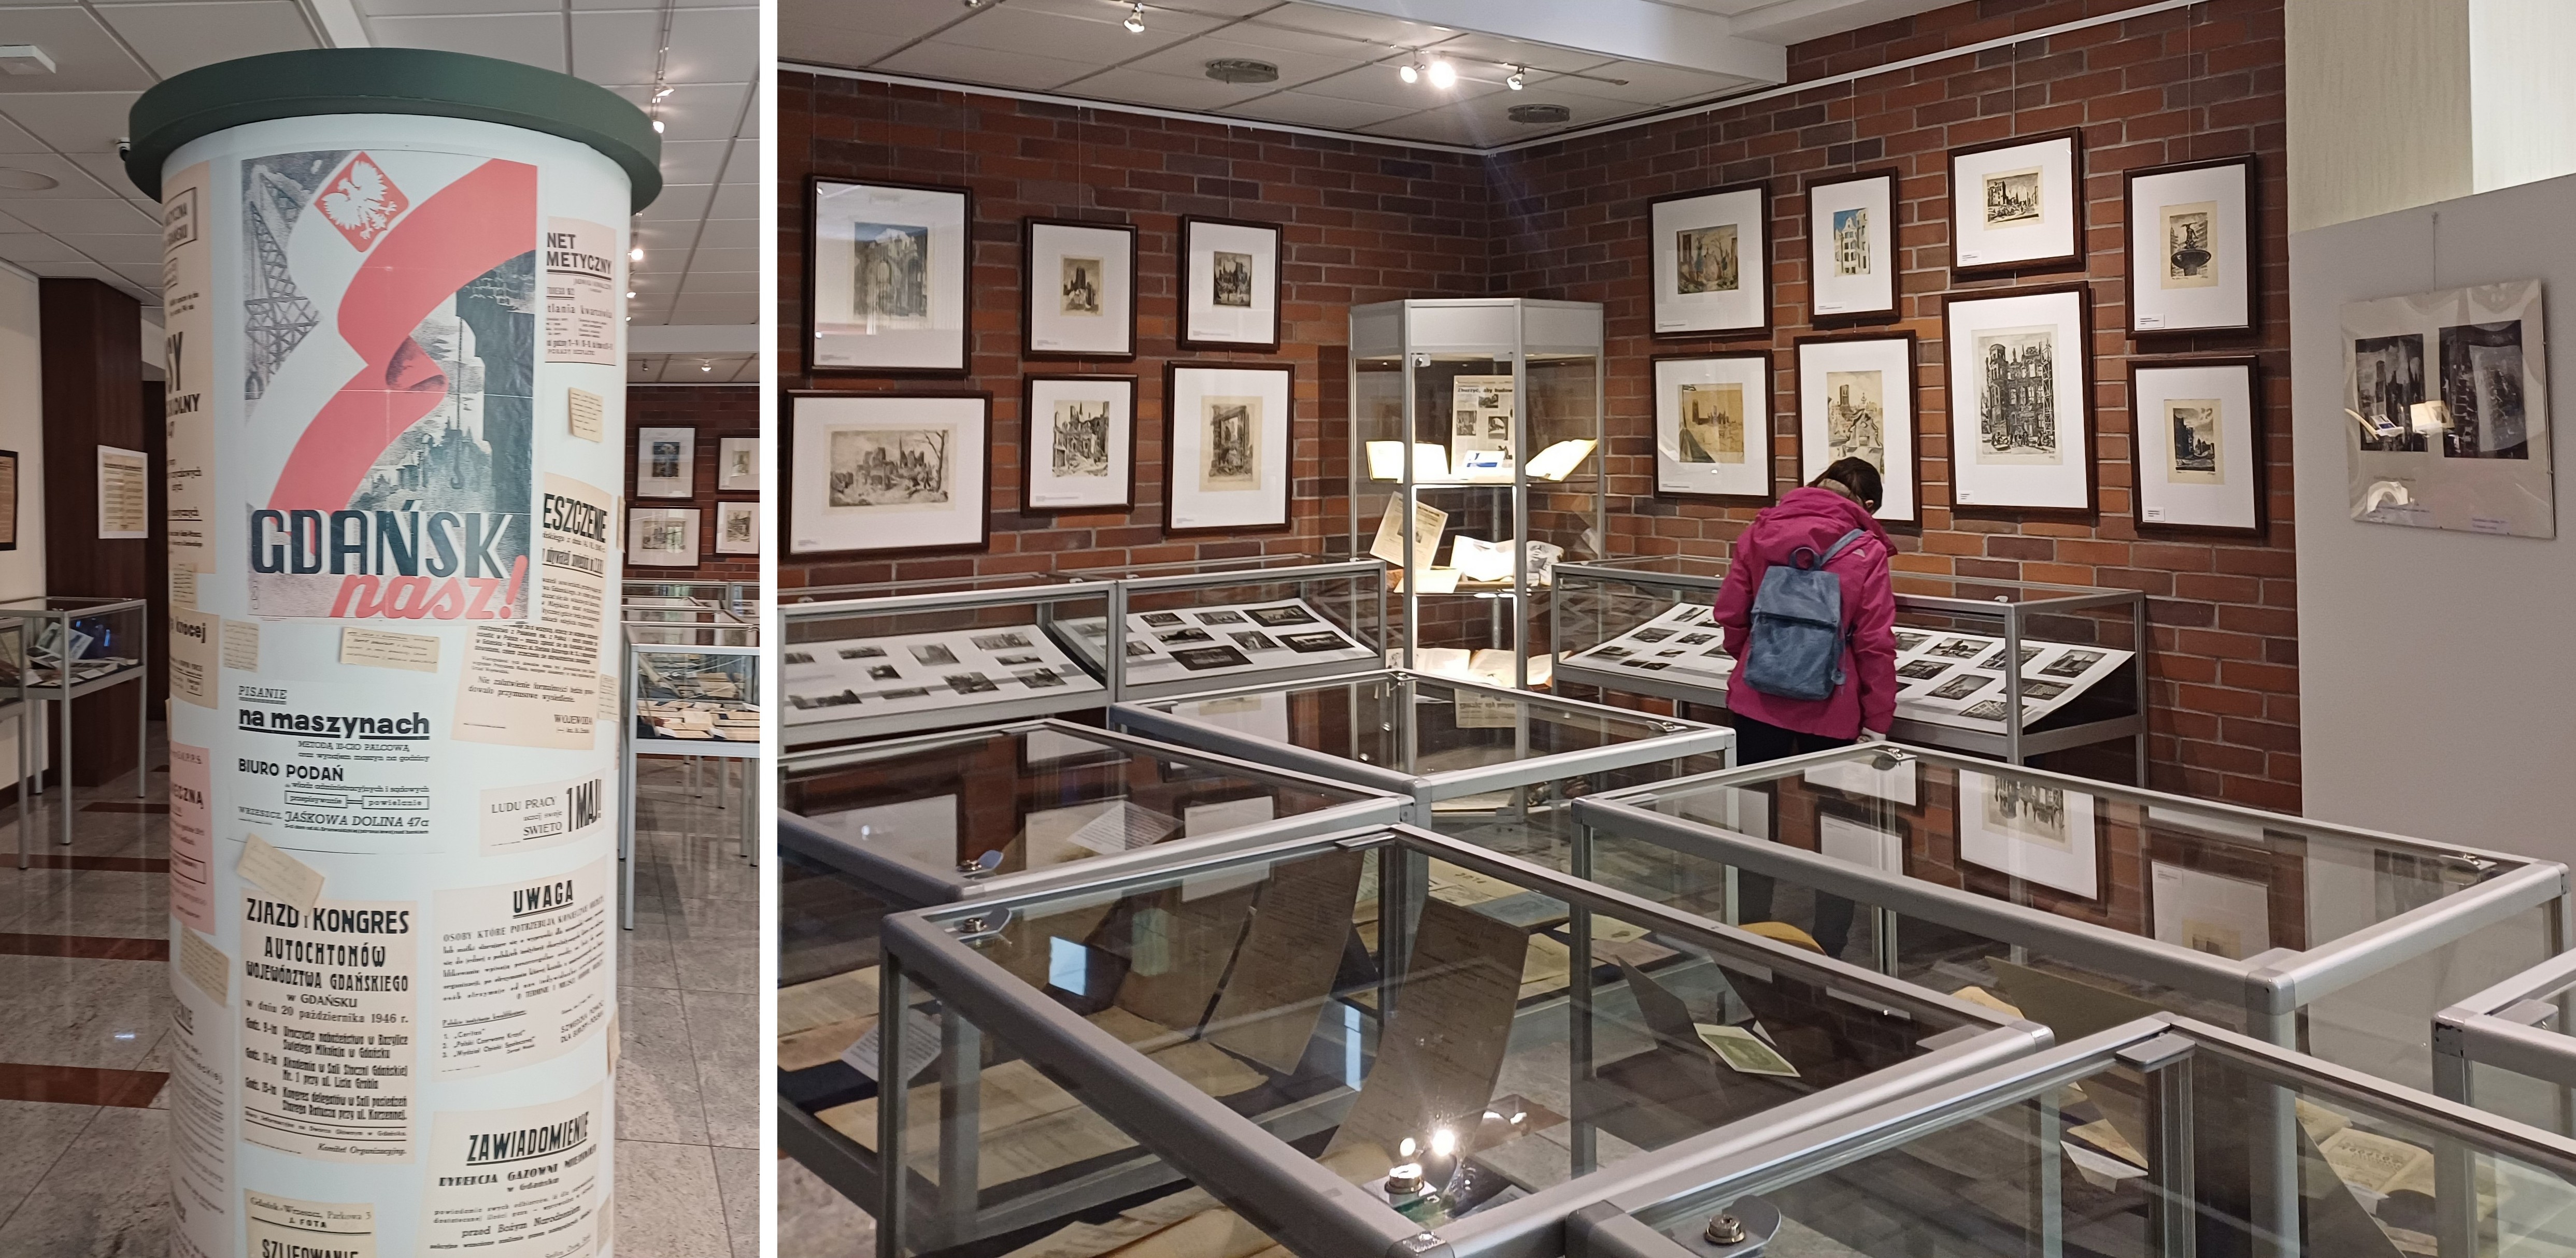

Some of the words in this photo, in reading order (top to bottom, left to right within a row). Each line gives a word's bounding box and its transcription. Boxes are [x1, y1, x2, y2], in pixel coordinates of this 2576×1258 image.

[547, 233, 576, 249] NET
[547, 251, 612, 274] METYCZNY
[251, 499, 512, 578] GDAŃSK
[329, 555, 528, 619] nasz!
[238, 685, 287, 699] PISANIE
[239, 709, 264, 727] na
[271, 712, 430, 738] maszynach
[238, 758, 279, 776] BIURO
[286, 765, 344, 781] PODAŃ
[368, 798, 422, 807] powielanie
[492, 801, 521, 813] LUDU
[525, 796, 557, 810] PRACY
[284, 811, 348, 827] JAŚKOWA
[352, 816, 403, 827] DOLINA
[407, 817, 430, 827] 47a
[513, 880, 573, 913] UWAGA
[247, 897, 300, 928] ZJAZD
[313, 908, 410, 934] KONGRES
[264, 936, 386, 967] AUTOCHTONÓW
[246, 961, 322, 989] WOJEWÓDZTWA
[330, 972, 408, 992] GDAŃSKIEGO
[300, 994, 358, 1008] GDAŃSKU
[298, 1010, 365, 1023] października
[371, 1013, 397, 1023] 1946
[507, 1164, 559, 1181] GAZOWNI
[461, 1226, 491, 1238] przed
